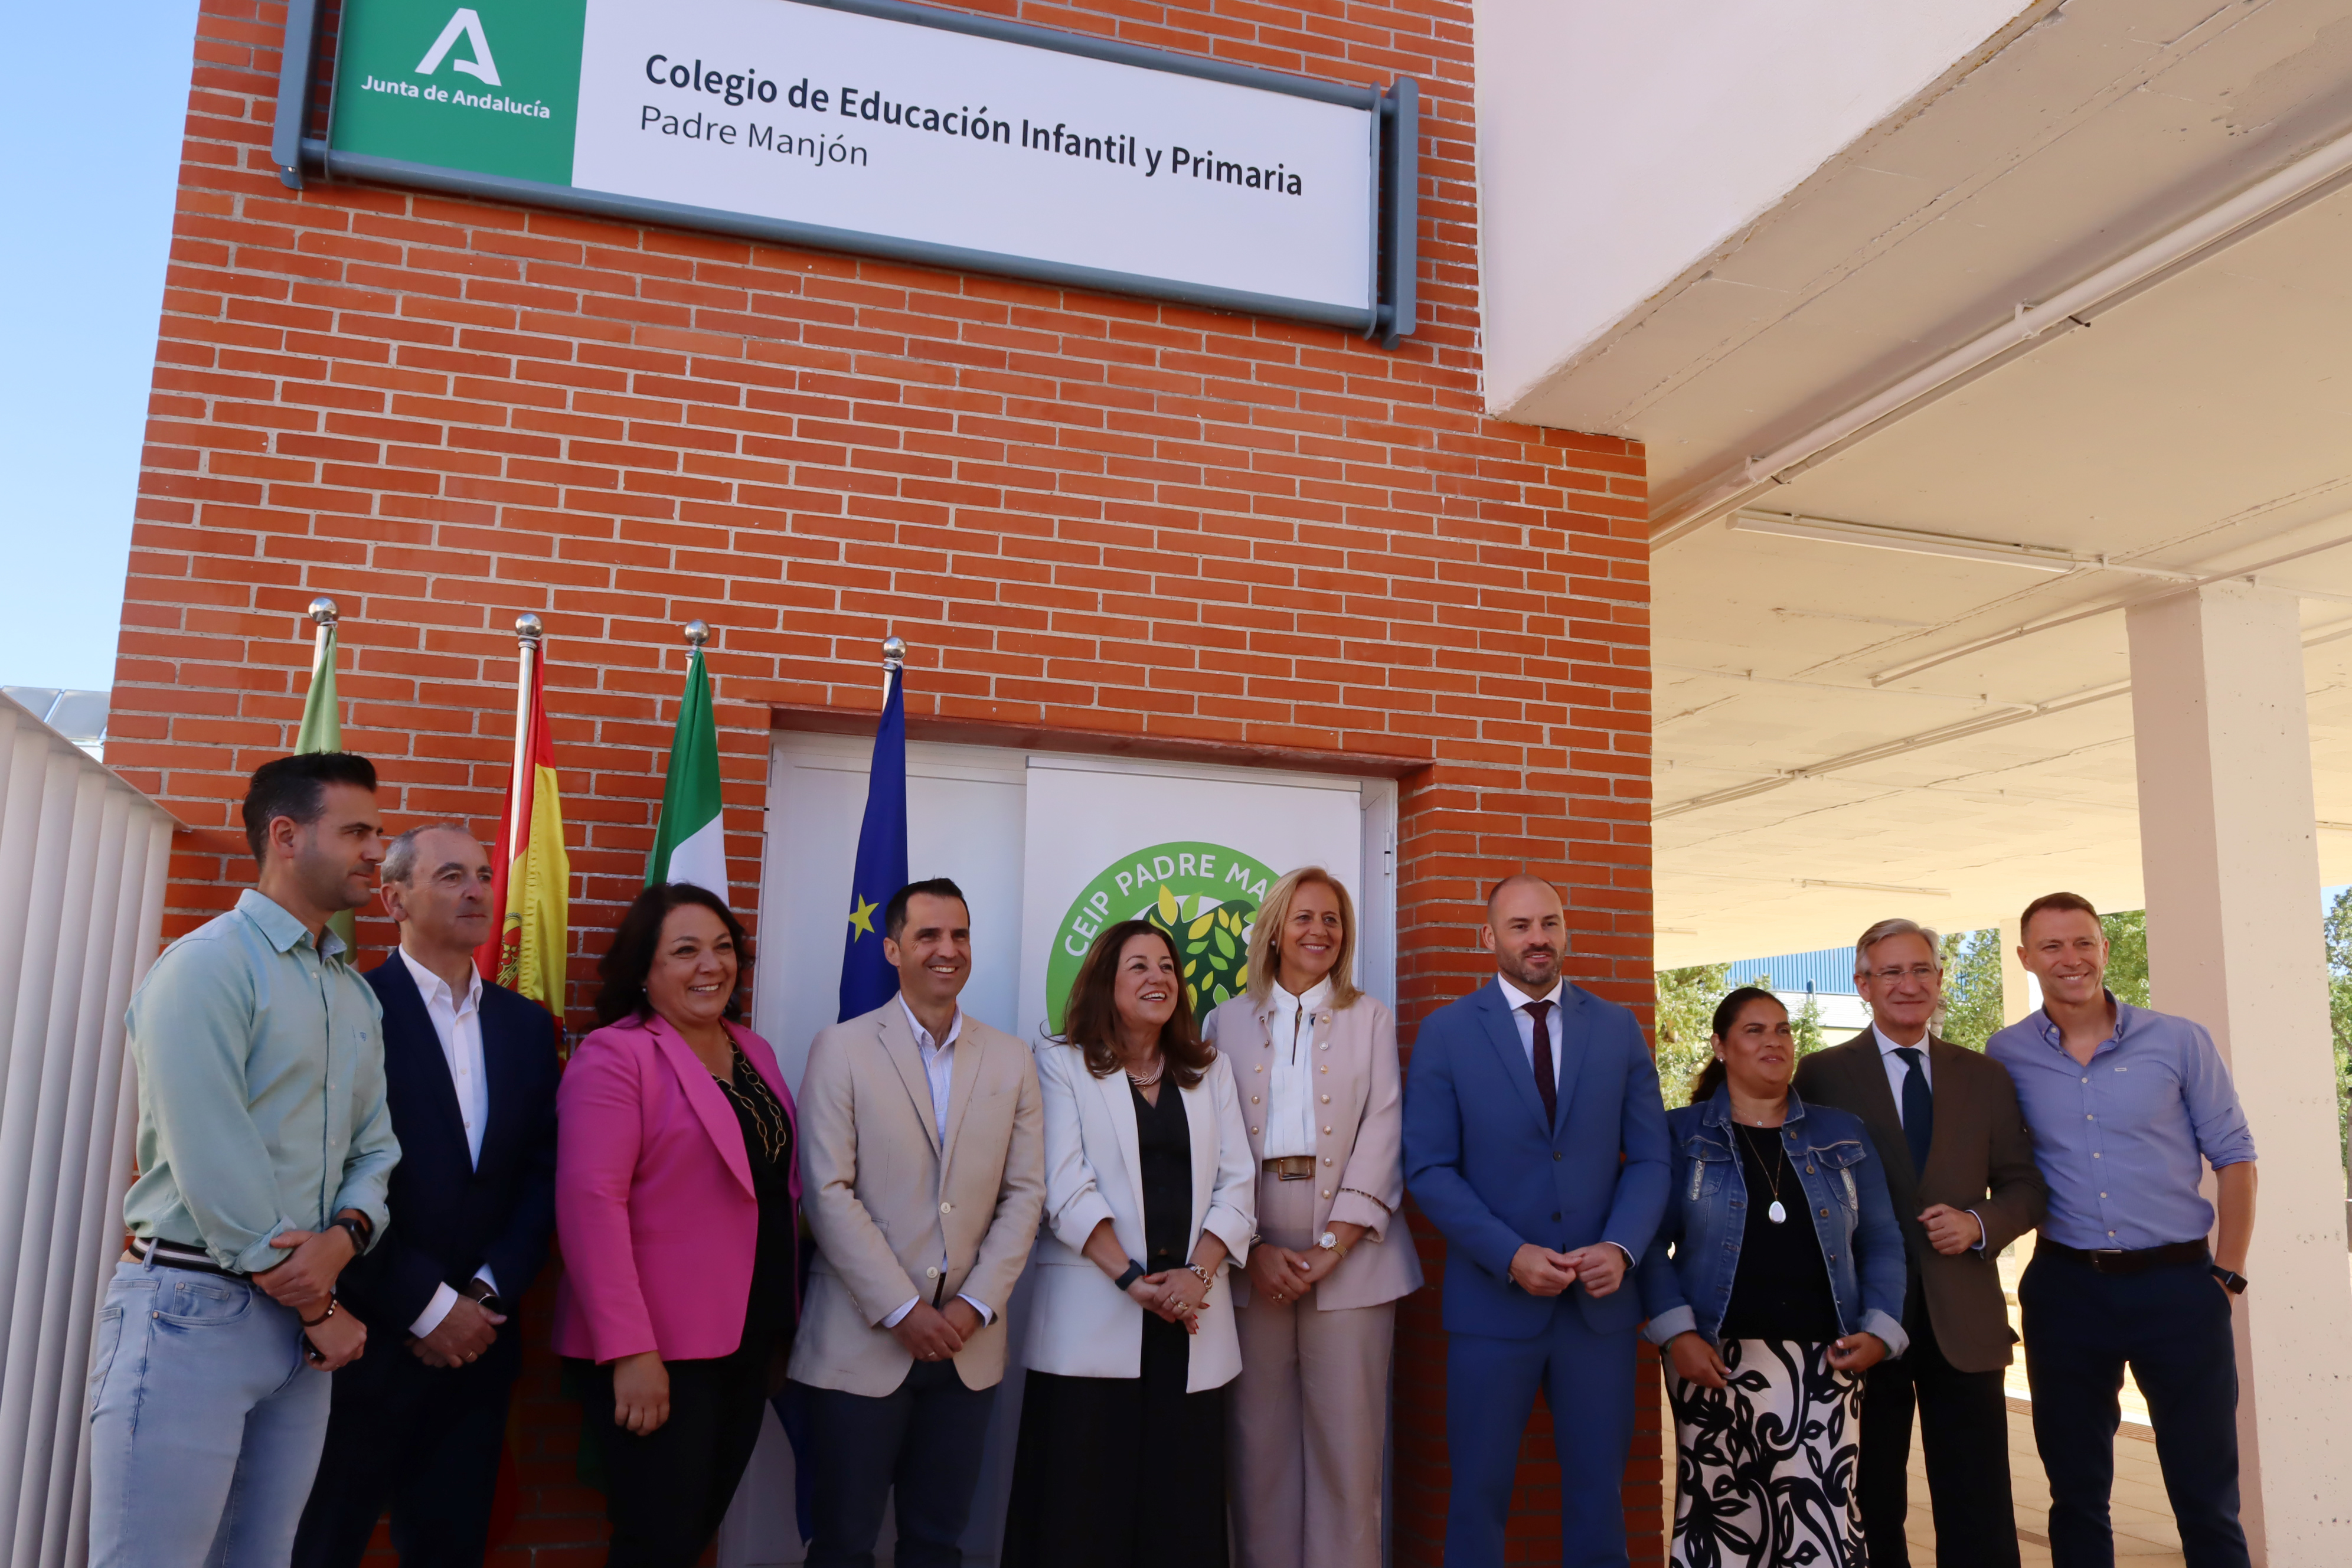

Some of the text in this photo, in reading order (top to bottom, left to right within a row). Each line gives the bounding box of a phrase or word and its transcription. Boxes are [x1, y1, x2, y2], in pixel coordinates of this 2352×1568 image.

[361, 75, 550, 119] Junta de Andalucía
[641, 104, 867, 167] Padre Manjón
[645, 54, 1302, 196] Colegio de Educación Infantil y Primaria
[1064, 853, 1268, 956] CEIP PADRE MA
